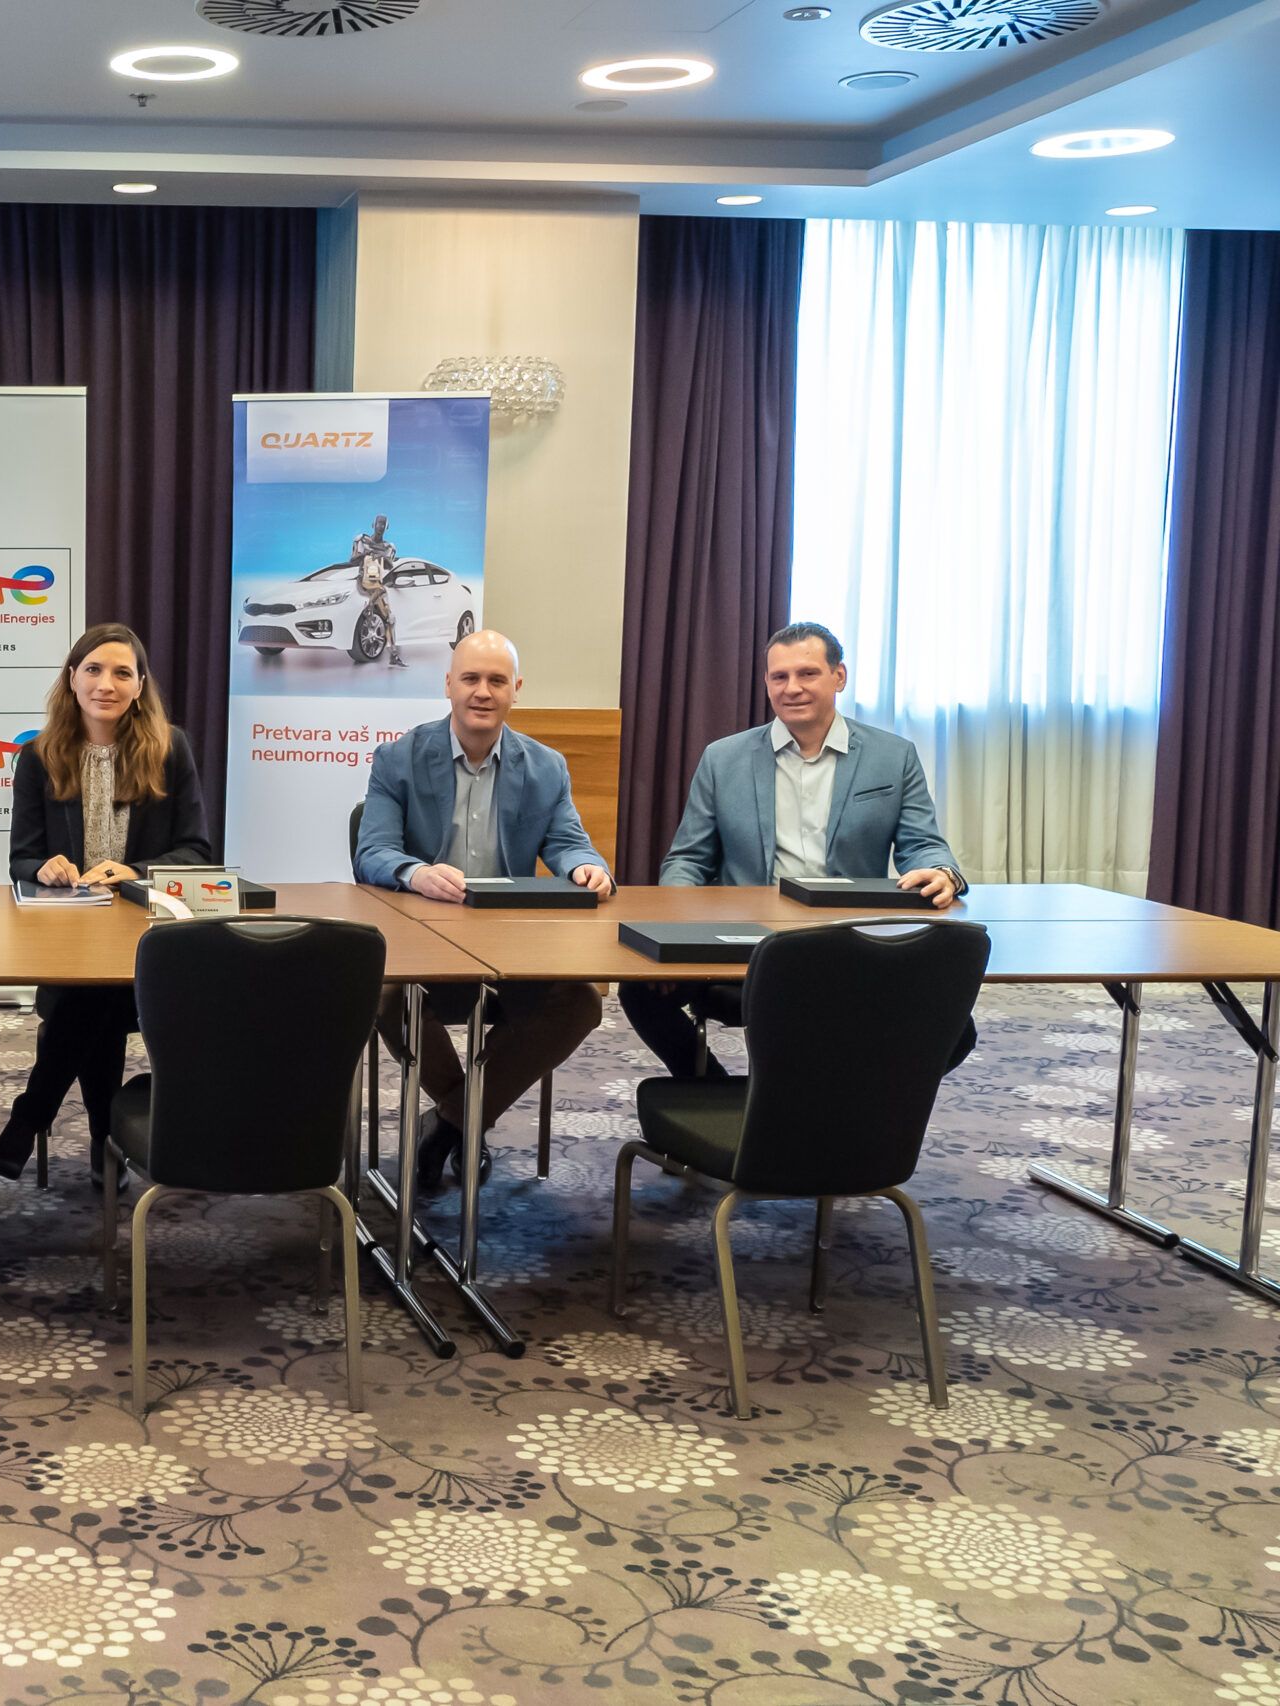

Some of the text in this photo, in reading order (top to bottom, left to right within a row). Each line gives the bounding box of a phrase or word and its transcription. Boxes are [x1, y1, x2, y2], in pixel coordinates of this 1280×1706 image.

[260, 432, 374, 450] QUARTZ
[252, 723, 412, 743] Pretvara vaš mo
[252, 749, 359, 767] neumornog
